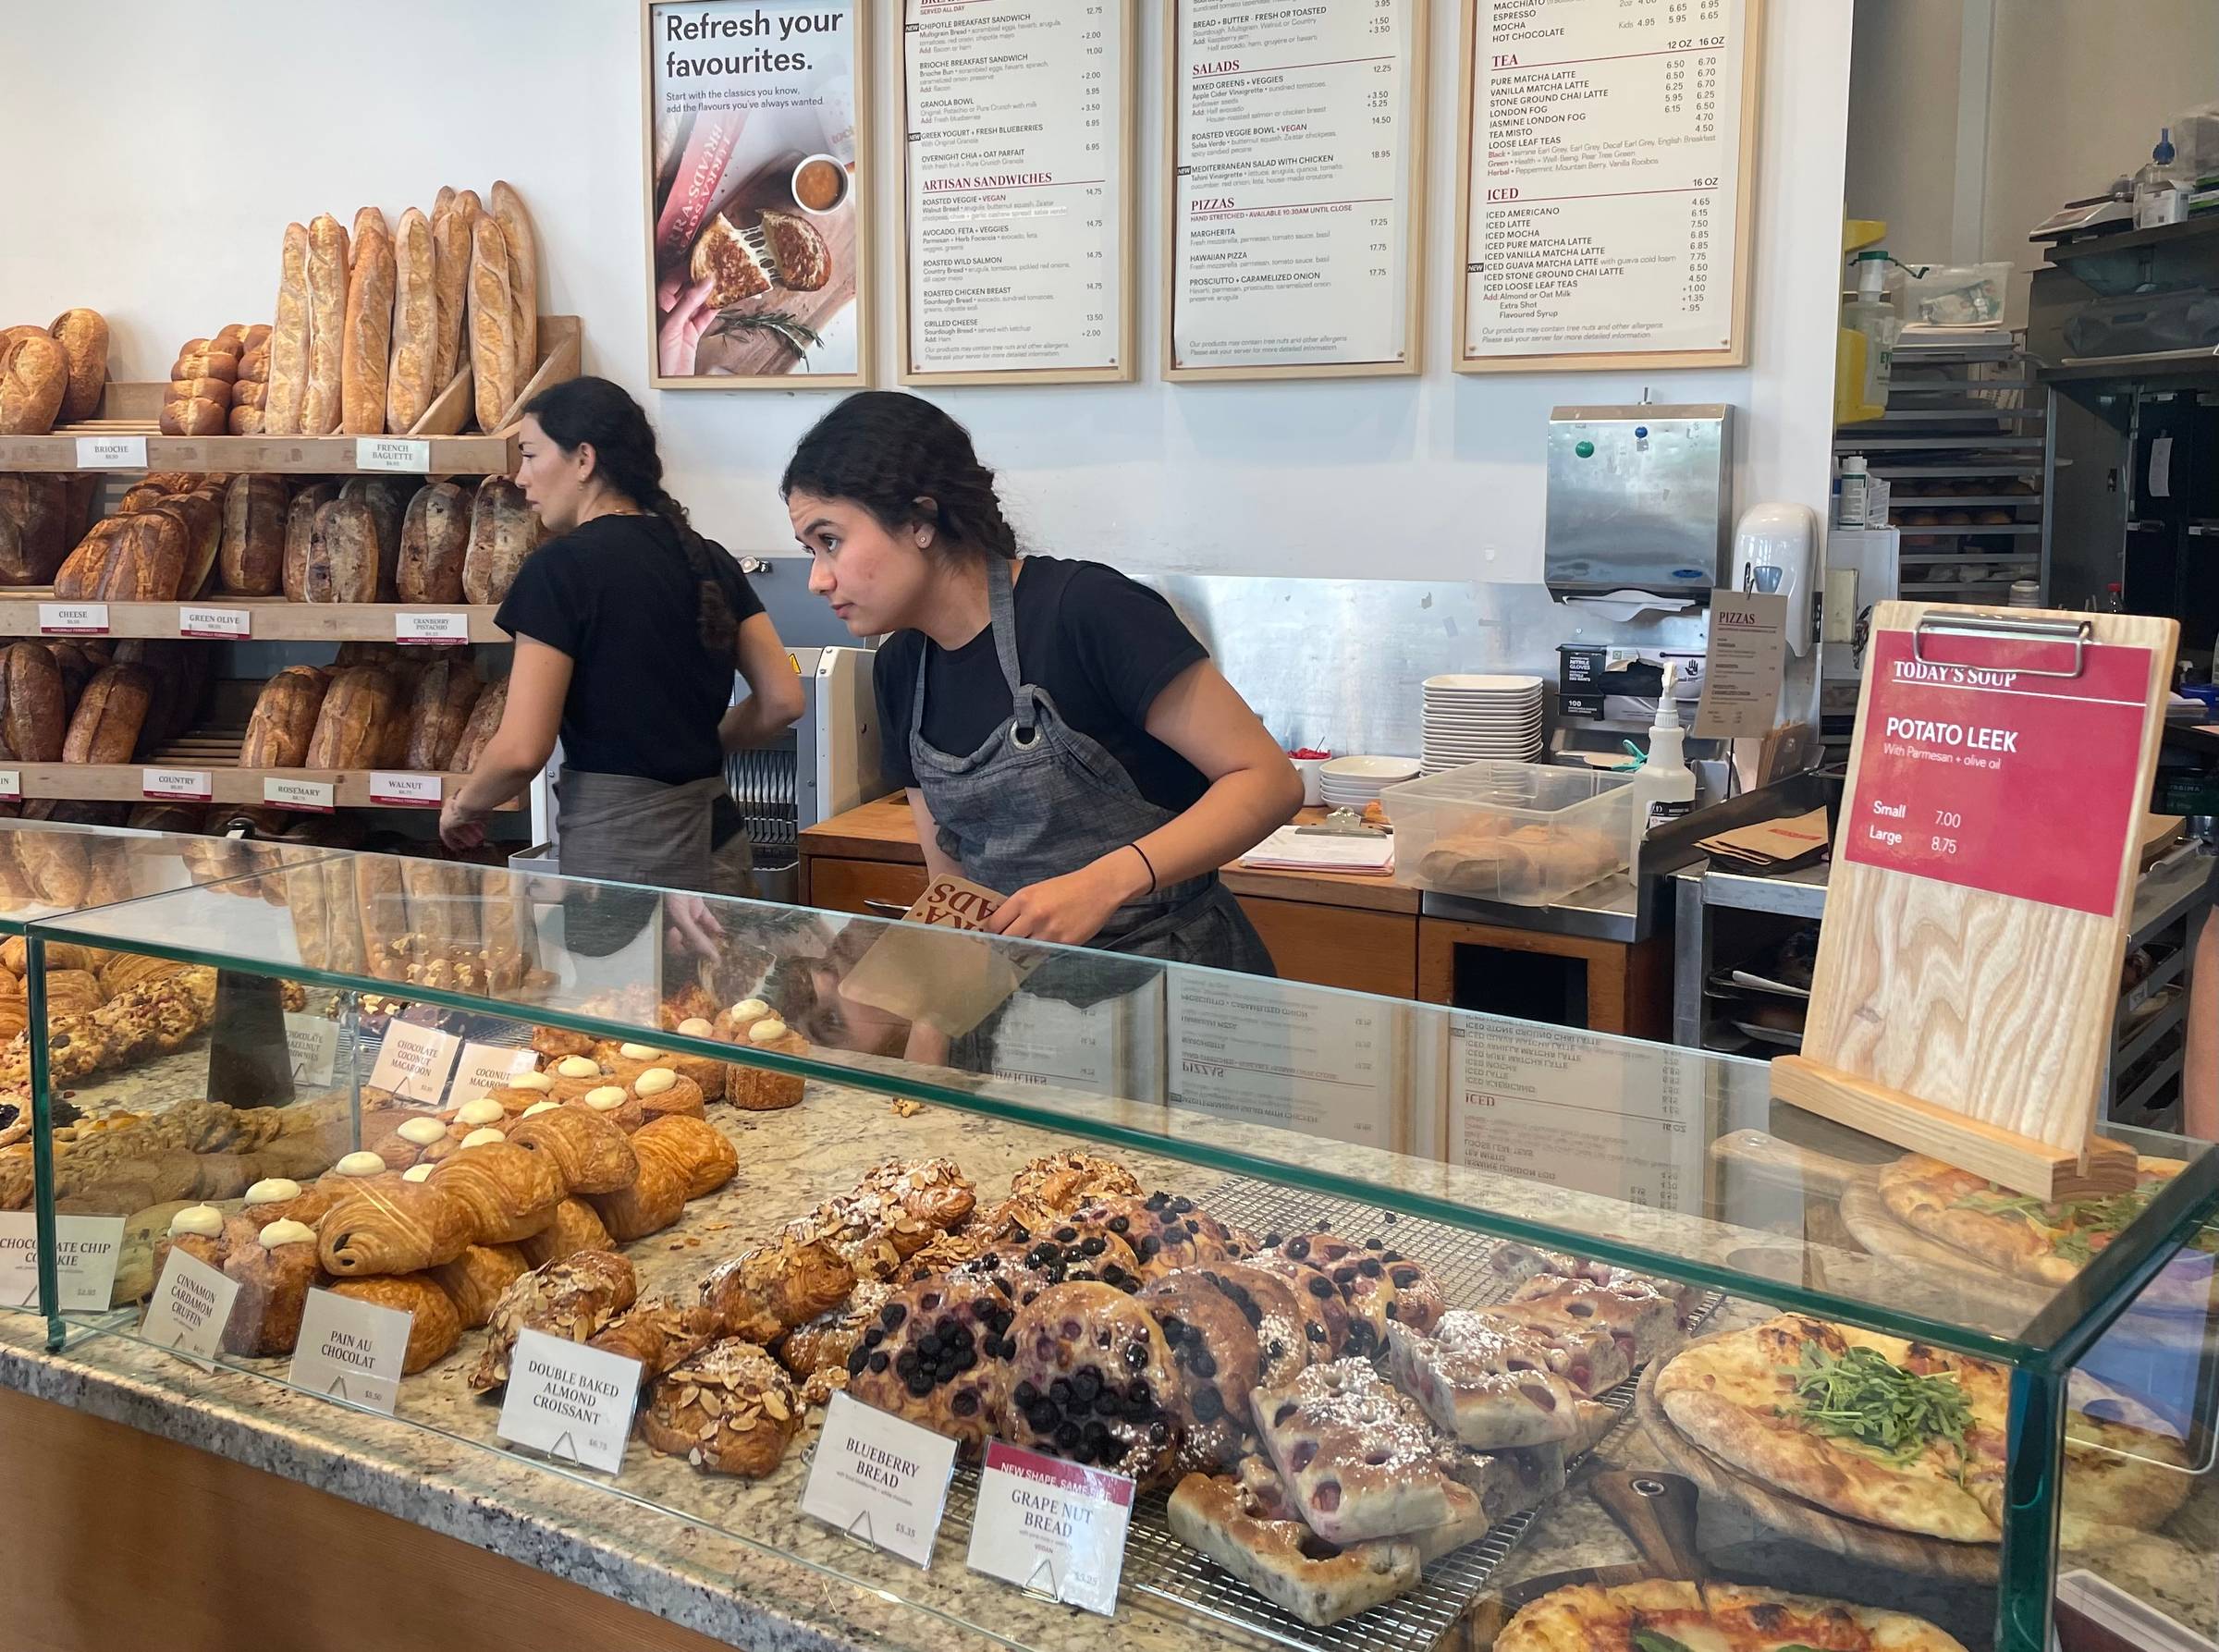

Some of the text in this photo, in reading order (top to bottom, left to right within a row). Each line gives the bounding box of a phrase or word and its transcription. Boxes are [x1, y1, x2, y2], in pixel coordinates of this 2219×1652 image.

[954, 18, 990, 28] BREAKFAST
[992, 14, 1031, 24] SANDWICH
[1193, 19, 1217, 29] BREAD
[1222, 15, 1249, 25] BUTTER
[1255, 12, 1279, 22] FRESH
[1293, 6, 1327, 17] TOASTED
[1493, 9, 1536, 21] ESPRESSO
[667, 9, 843, 41] Refresh your
[1493, 22, 1526, 31] MOCHA
[1492, 28, 1564, 43] HOT CHOCOLATE
[1678, 39, 1692, 48] OZ
[1699, 38, 1709, 46] 16
[1710, 36, 1724, 45] OZ
[667, 47, 813, 78] favourites.
[920, 54, 1028, 69] BRIOCHE BREAKFAST SANDWICH
[1193, 60, 1240, 76] SALADS
[1492, 55, 1518, 67] TEA
[1193, 76, 1283, 92] MIXED GREENS VEGGIES
[1490, 71, 1576, 86] PURE MATCHA LATTE
[667, 92, 686, 101] Start
[689, 92, 705, 100] with
[708, 91, 721, 99] the
[724, 89, 755, 98] classics
[757, 89, 773, 97] you
[1490, 80, 1589, 97] VANILLA MATCHA LATTE
[667, 104, 680, 113] add
[698, 103, 730, 111] flavours
[733, 101, 759, 111] you've
[761, 99, 790, 107] always
[1490, 90, 1609, 107] STONE GROUND CHAI LATTE
[1490, 105, 1548, 117] LONDON FOG
[1490, 113, 1586, 128] JASMINE LONDON FOG
[1490, 128, 1533, 139] TEA MISTO
[1489, 137, 1561, 149] LOOSE LEAF TEAS
[1192, 155, 1333, 174] MEDITERRANEAN SALAD WITH CHICKEN
[923, 173, 1052, 190] ARTISAN SANDWICHES
[1693, 177, 1719, 187] 16 OZ
[923, 194, 1006, 206] ROASTED VEGGIE VEGAN
[1488, 188, 1519, 201] ICED
[1191, 198, 1234, 211] PIZZAS
[1486, 207, 1560, 219] ICED AMERICANO
[1486, 220, 1531, 230] ICED LATTE
[1190, 228, 1235, 239] MARGHERITA
[1485, 230, 1539, 240] ICED MOCHA
[924, 256, 1002, 267] ROASTED WILD SALMON
[1190, 253, 1226, 262] HAWAIIAN
[924, 289, 953, 298] ROASTED
[987, 287, 1011, 295] BREAST
[377, 444, 409, 452] FRENCH
[372, 452, 413, 460] BAGUETTE
[190, 614, 240, 624] GREEN OLIVE
[1719, 611, 1755, 624] PIZZAS
[1894, 660, 2017, 688] TODAY'S SOUP
[1886, 717, 2018, 753] POTATO LEEK
[1883, 743, 1905, 757] With
[1906, 746, 1953, 764] Parmesan
[1964, 754, 1986, 767] olive
[1989, 757, 2001, 770] oil
[277, 786, 320, 796] ROSEMARY
[389, 780, 423, 789] WALNUT
[1873, 801, 1961, 828] Small 7.00
[1870, 826, 1956, 854] Large 8.75
[288, 1031, 323, 1044] HOCOLATE
[398, 1040, 438, 1058] CHOCOLATE
[398, 1050, 431, 1066] COCONUT
[391, 1059, 431, 1077] MACAROON
[476, 1069, 509, 1081] COCONUT
[0, 1238, 110, 1254] CHOCATE CHIP
[25, 1252, 79, 1266] CKIE
[178, 1273, 215, 1303] CINNAMON
[171, 1286, 213, 1317] CARDAMOM
[172, 1302, 202, 1327] CRUFFIN
[331, 1330, 373, 1352] PAIN AU
[322, 1344, 375, 1369] CHOCOLAT
[529, 1360, 619, 1398] DOUBLE BAKED
[544, 1382, 596, 1407] ALMOND
[533, 1394, 602, 1425] CROISSANT
[846, 1438, 920, 1477] BLUEBERRY
[856, 1461, 899, 1488] BREAD
[1000, 1462, 1024, 1476] NEW
[1060, 1480, 1088, 1496] SAME
[1011, 1488, 1093, 1524] GRAPE NUT
[1024, 1511, 1073, 1538] BREAD
